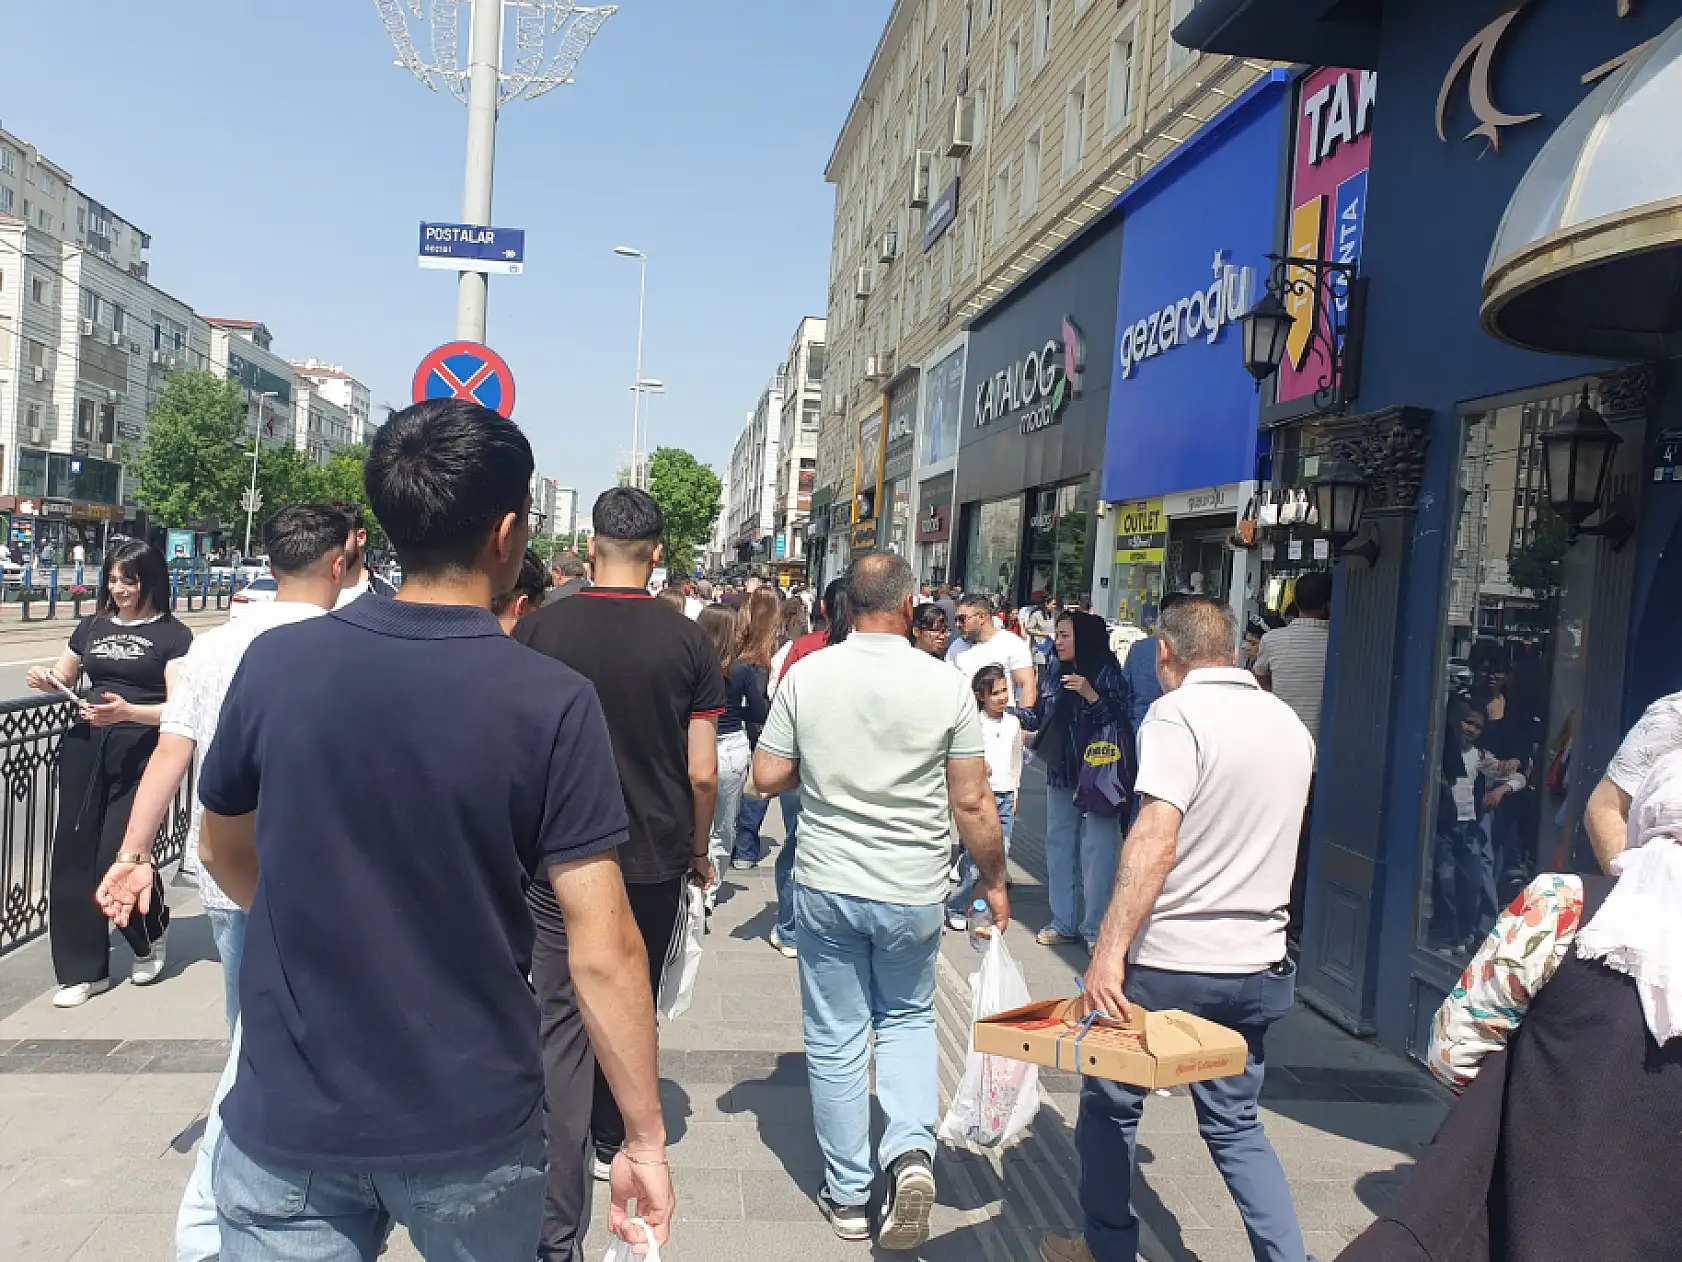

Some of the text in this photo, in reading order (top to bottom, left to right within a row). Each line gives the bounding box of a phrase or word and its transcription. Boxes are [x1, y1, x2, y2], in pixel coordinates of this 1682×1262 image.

[425, 226, 495, 244] POSTALAR
[1120, 248, 1252, 380] gezeroğlu
[973, 339, 1058, 428] KATALOG
[1123, 509, 1161, 534] OUTLET
